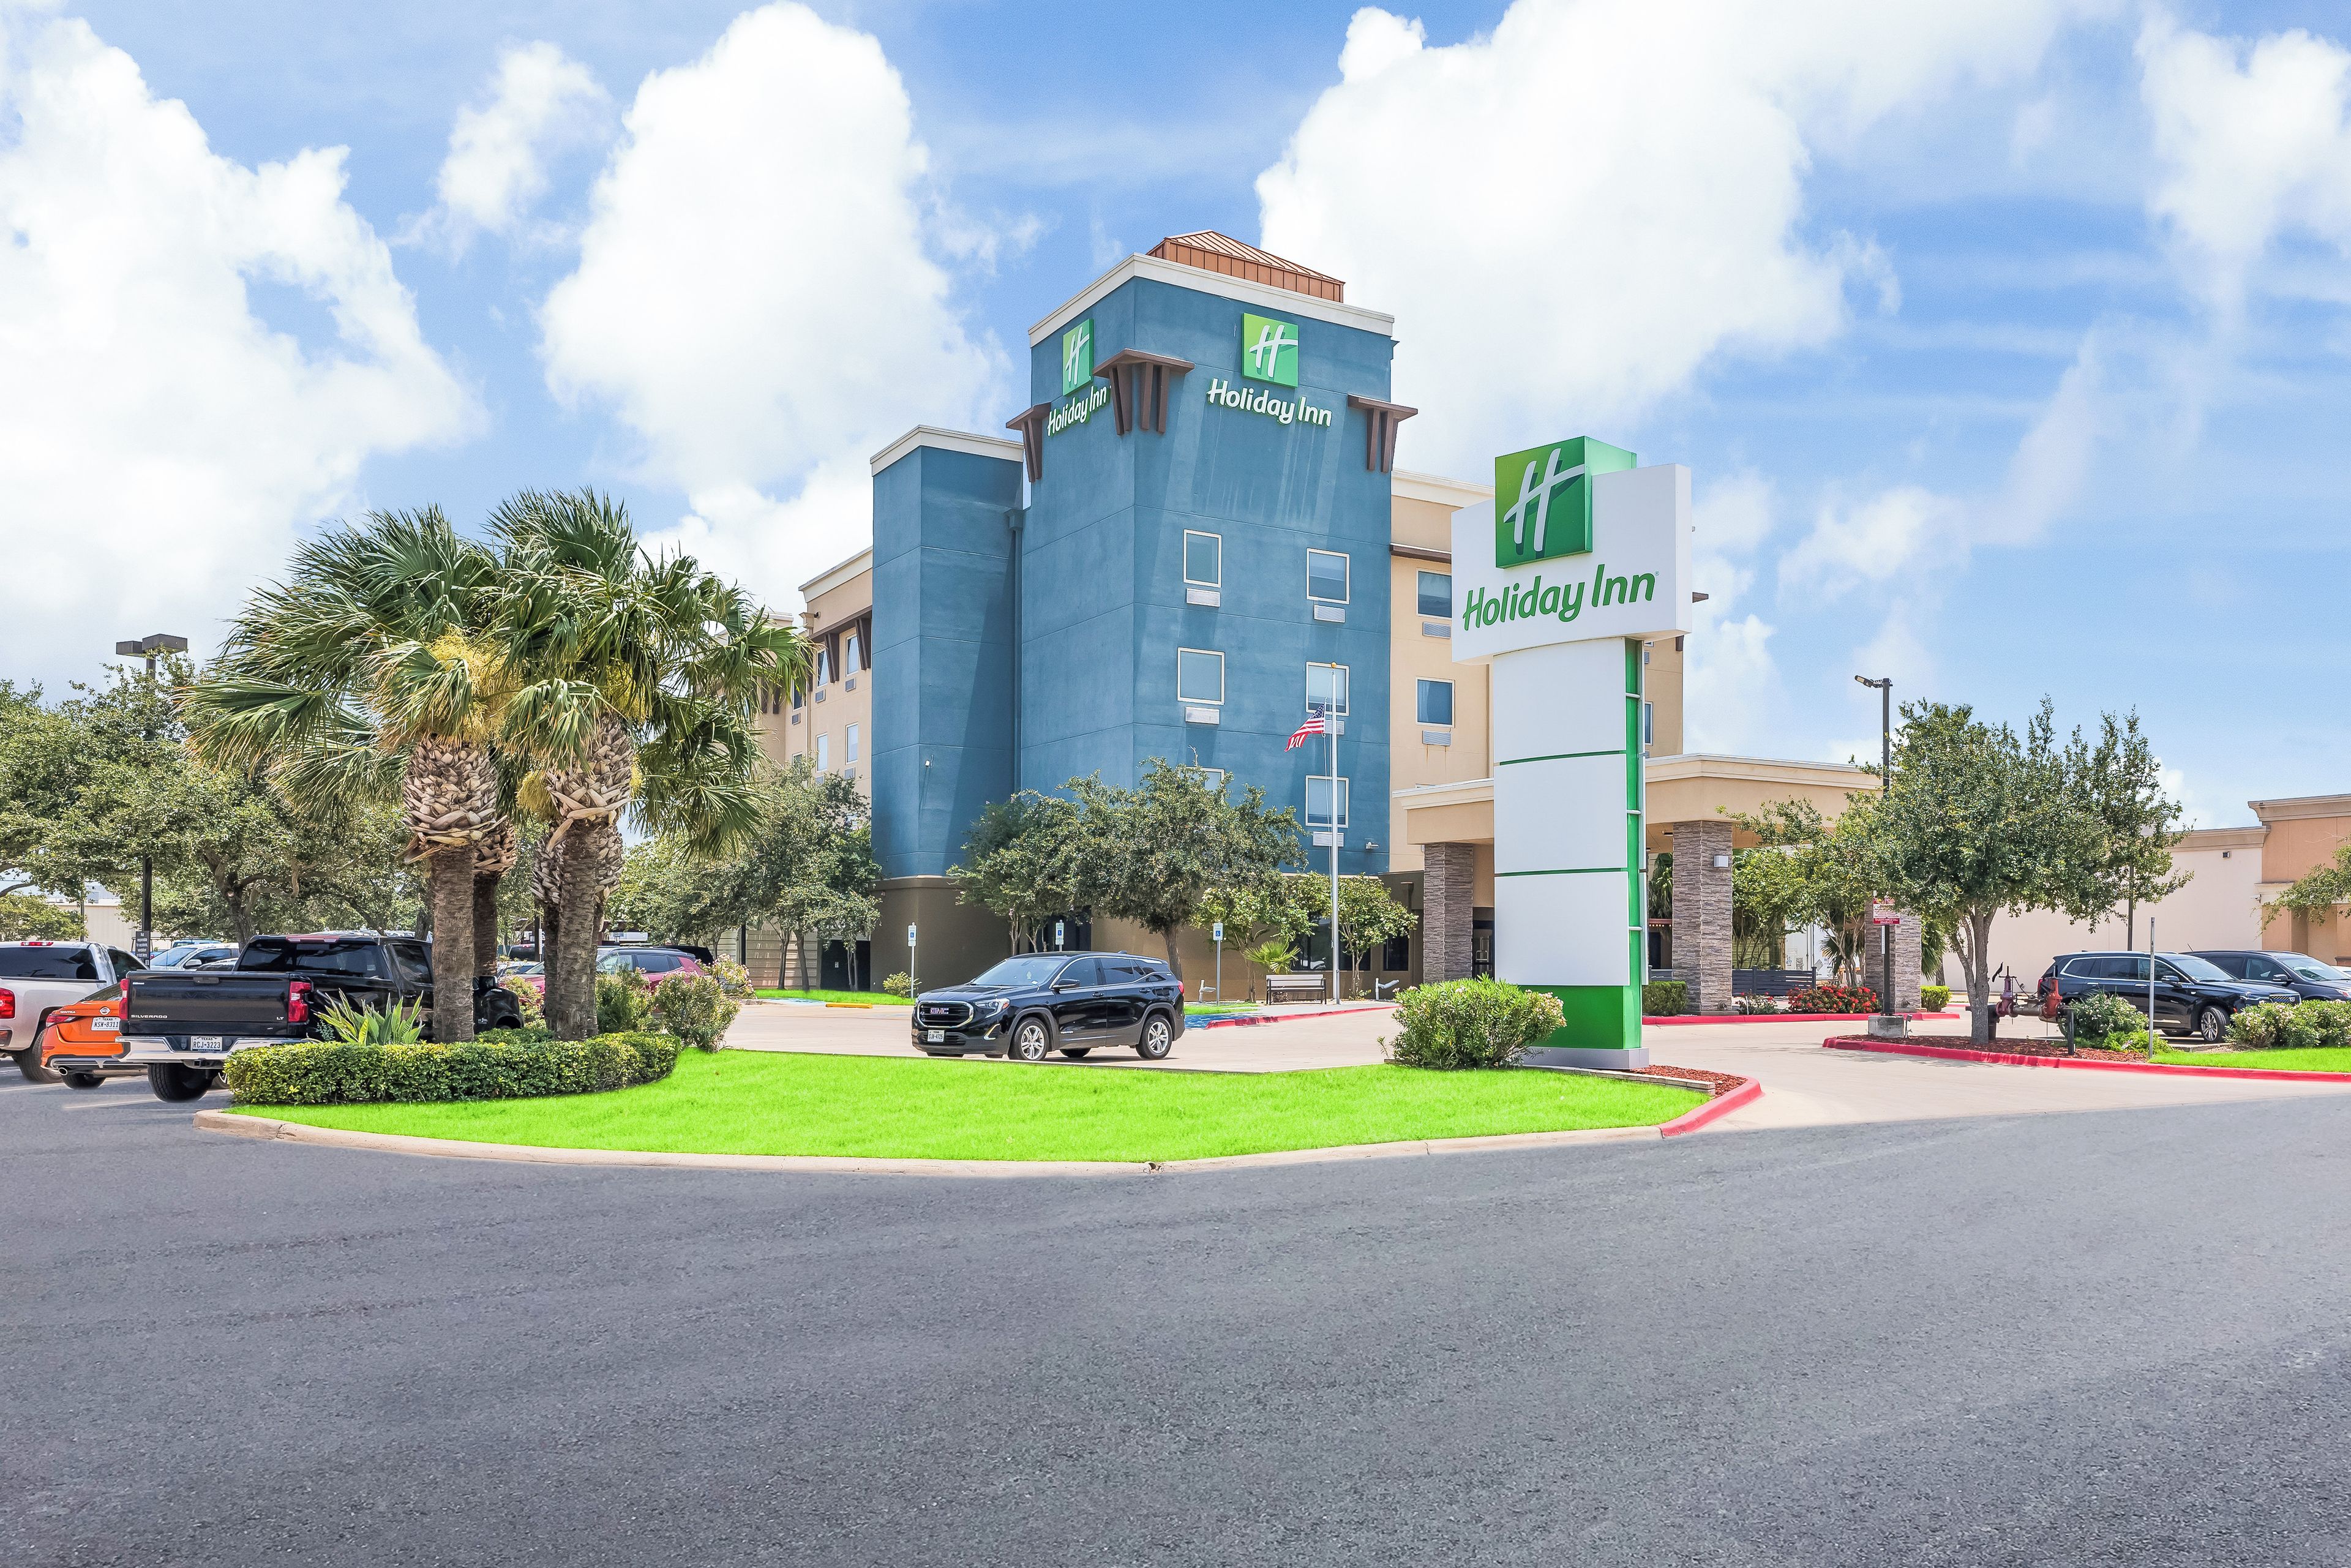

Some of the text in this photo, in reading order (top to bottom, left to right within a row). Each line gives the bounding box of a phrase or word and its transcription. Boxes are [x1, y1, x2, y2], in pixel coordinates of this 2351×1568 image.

[1047, 385, 1107, 437] Holiday Inn
[1206, 378, 1333, 427] Holiday Inn
[1463, 563, 1655, 631] Holiday Inn
